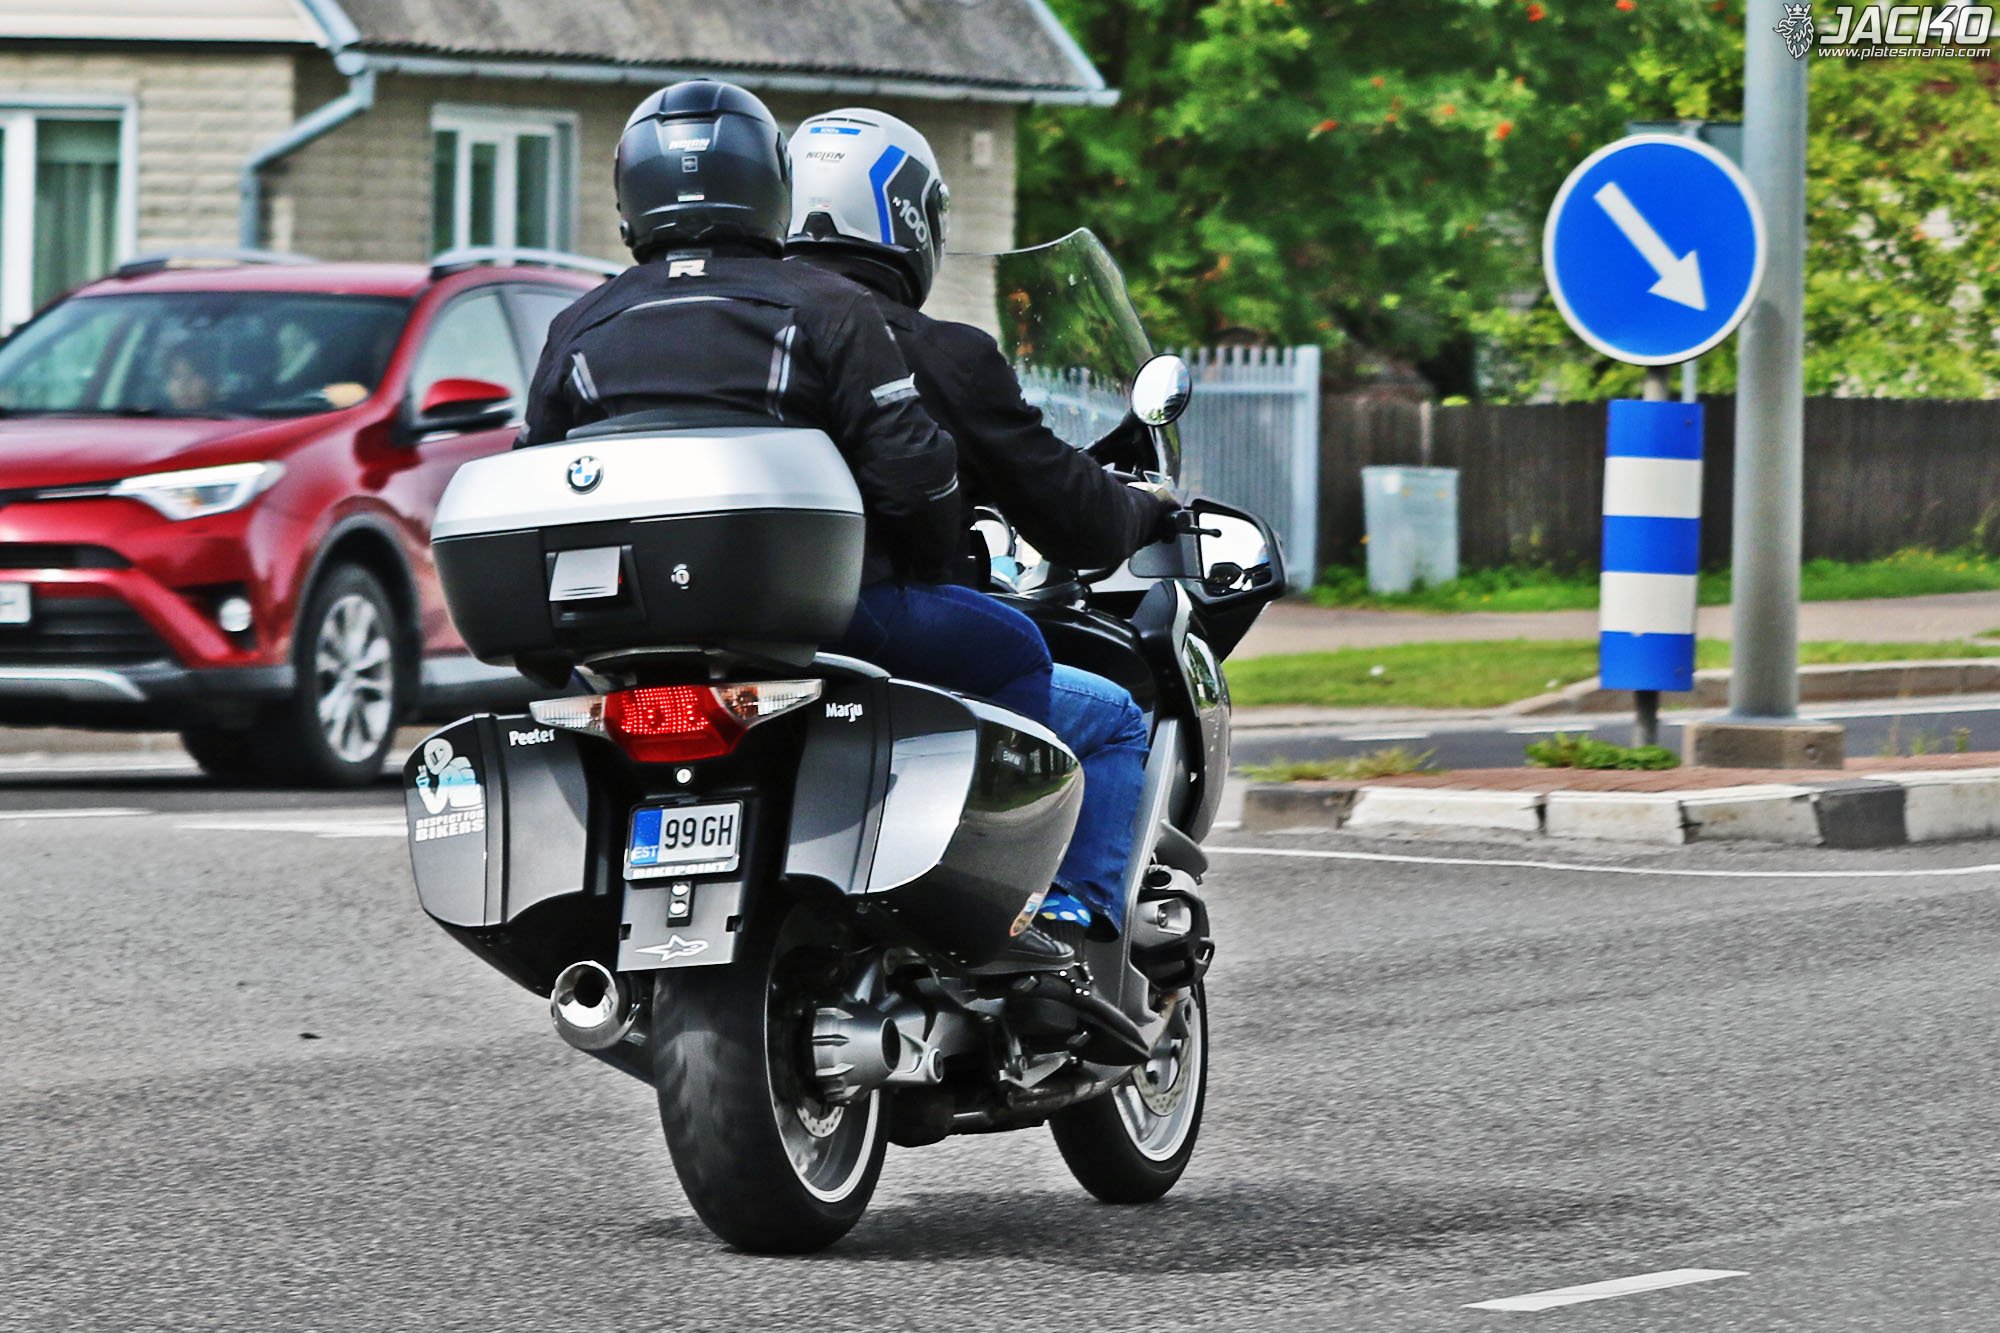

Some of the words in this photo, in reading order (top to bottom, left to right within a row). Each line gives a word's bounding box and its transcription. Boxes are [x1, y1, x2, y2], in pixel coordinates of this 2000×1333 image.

[825, 702, 864, 722] Marju
[508, 728, 556, 747] Peeter
[415, 812, 463, 829] RESPECT
[463, 809, 485, 821] FOR
[415, 819, 485, 842] BIKERS
[633, 845, 659, 859] EST
[632, 861, 729, 879] BIKEPOINT
